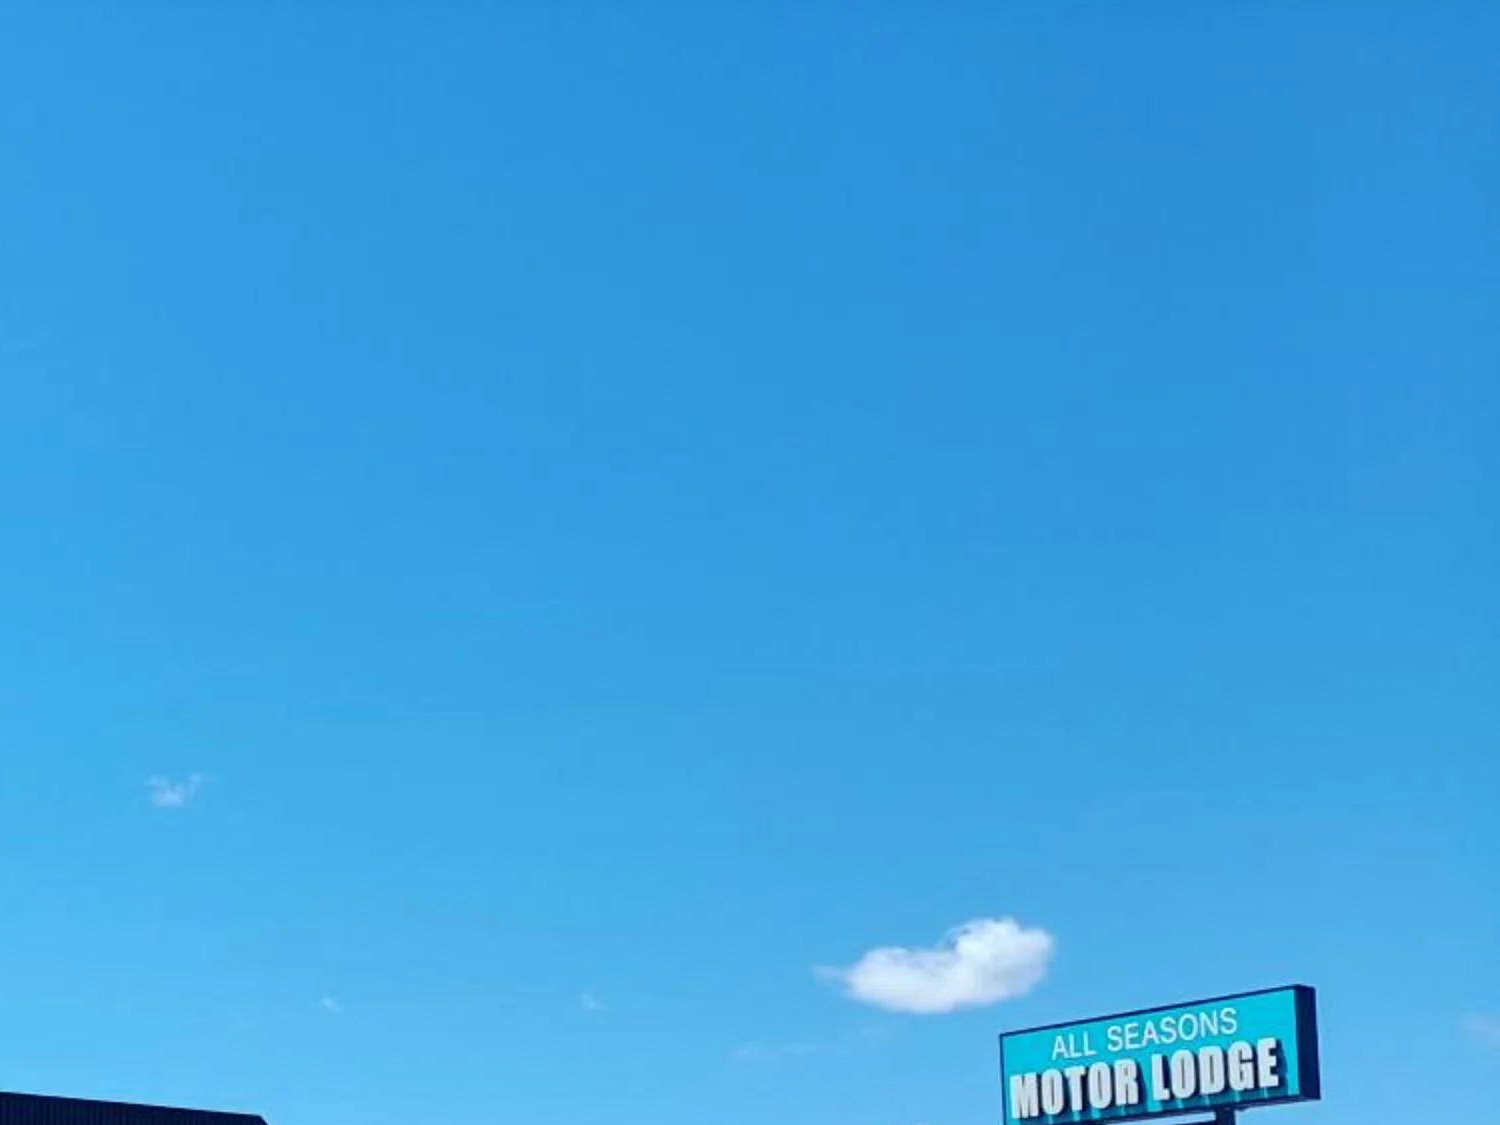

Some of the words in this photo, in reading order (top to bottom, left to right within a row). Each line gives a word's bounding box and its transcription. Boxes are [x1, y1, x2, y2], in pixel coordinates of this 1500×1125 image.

[1052, 1031, 1097, 1060] ALL
[1107, 1007, 1238, 1052] SEASONS
[1009, 1058, 1140, 1119] MOTOR
[1151, 1037, 1279, 1101] LODGE
